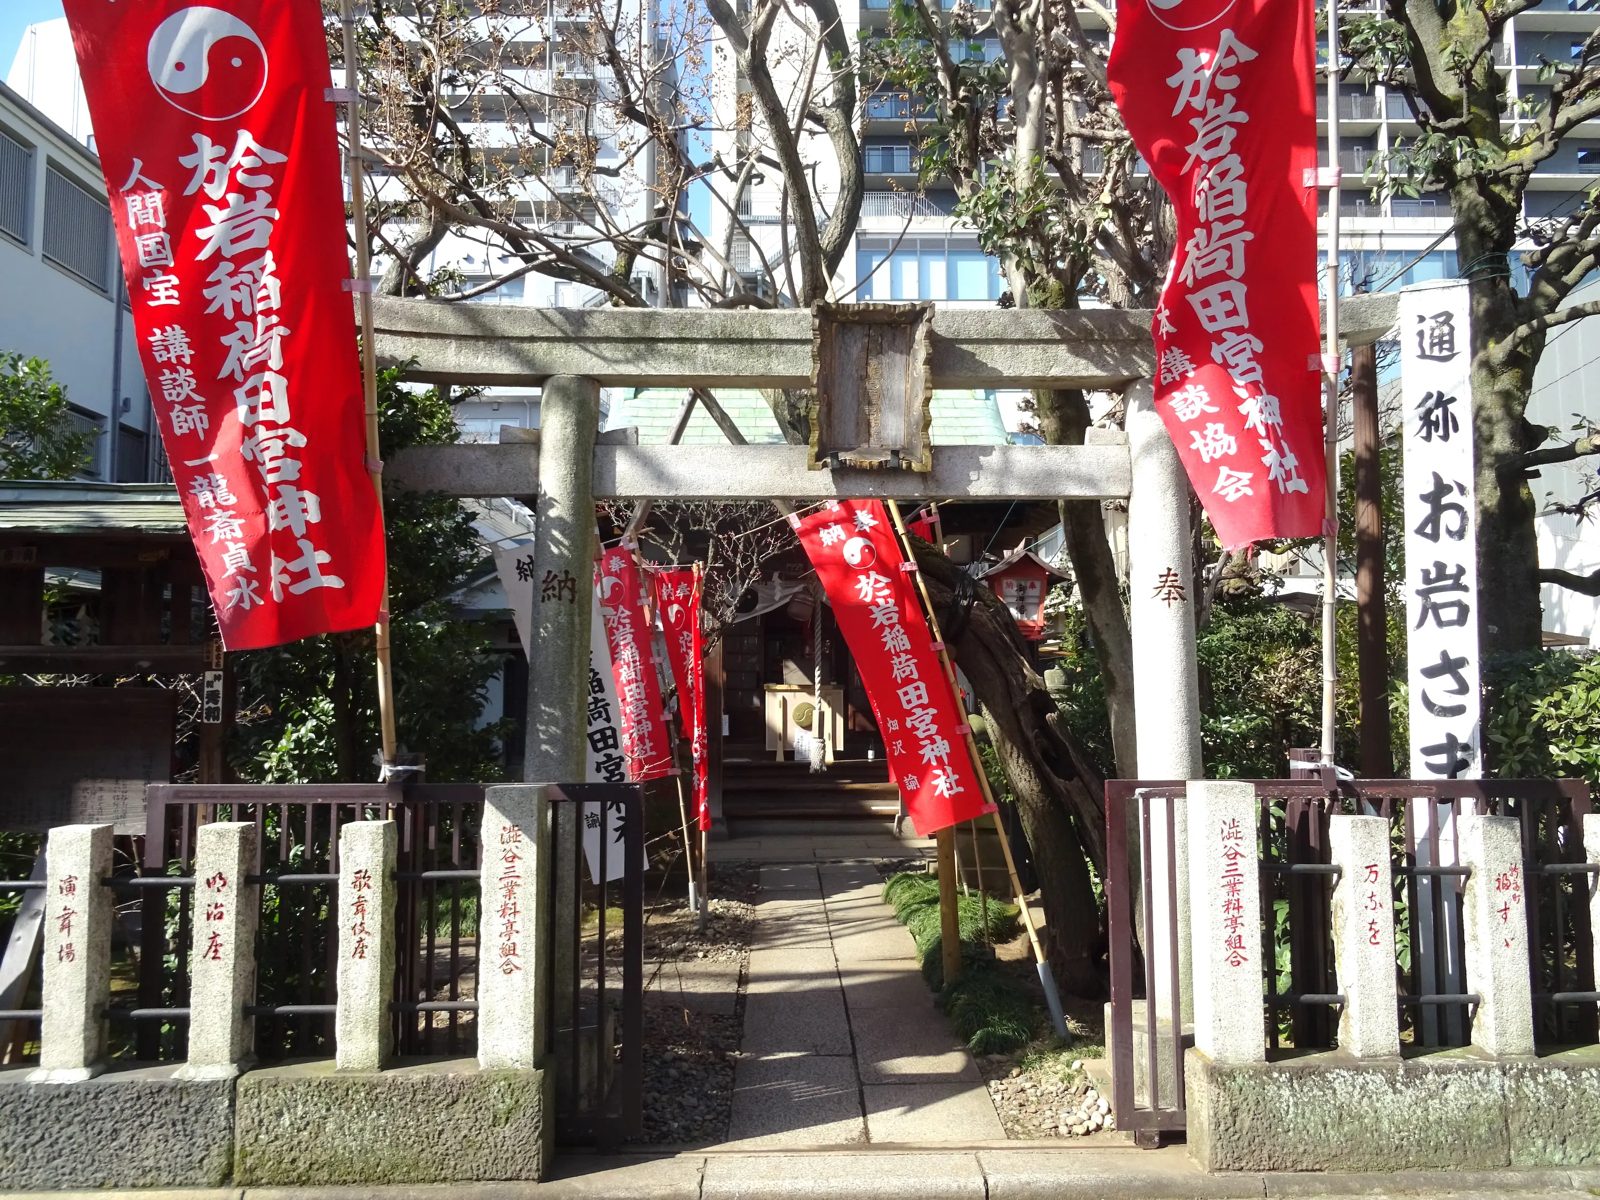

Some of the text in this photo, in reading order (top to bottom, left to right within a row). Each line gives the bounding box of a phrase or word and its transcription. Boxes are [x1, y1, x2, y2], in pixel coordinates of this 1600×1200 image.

[1165, 28, 1310, 495] 於岩稲荷田宮神社
[119, 157, 266, 613] 人間国宝 講談師 一龍斎貞水
[178, 128, 345, 604] 於岩稲荷田宮神社
[818, 508, 880, 547] 奉納
[1413, 313, 1475, 779] 通称お岩さま
[541, 569, 577, 605] 納
[1151, 566, 1188, 608] 奉
[853, 570, 965, 799] 於岩稲荷田宮神社
[55, 874, 79, 964] 演舞場
[202, 871, 228, 961] 明治座
[350, 868, 372, 960] 歌舞伎座
